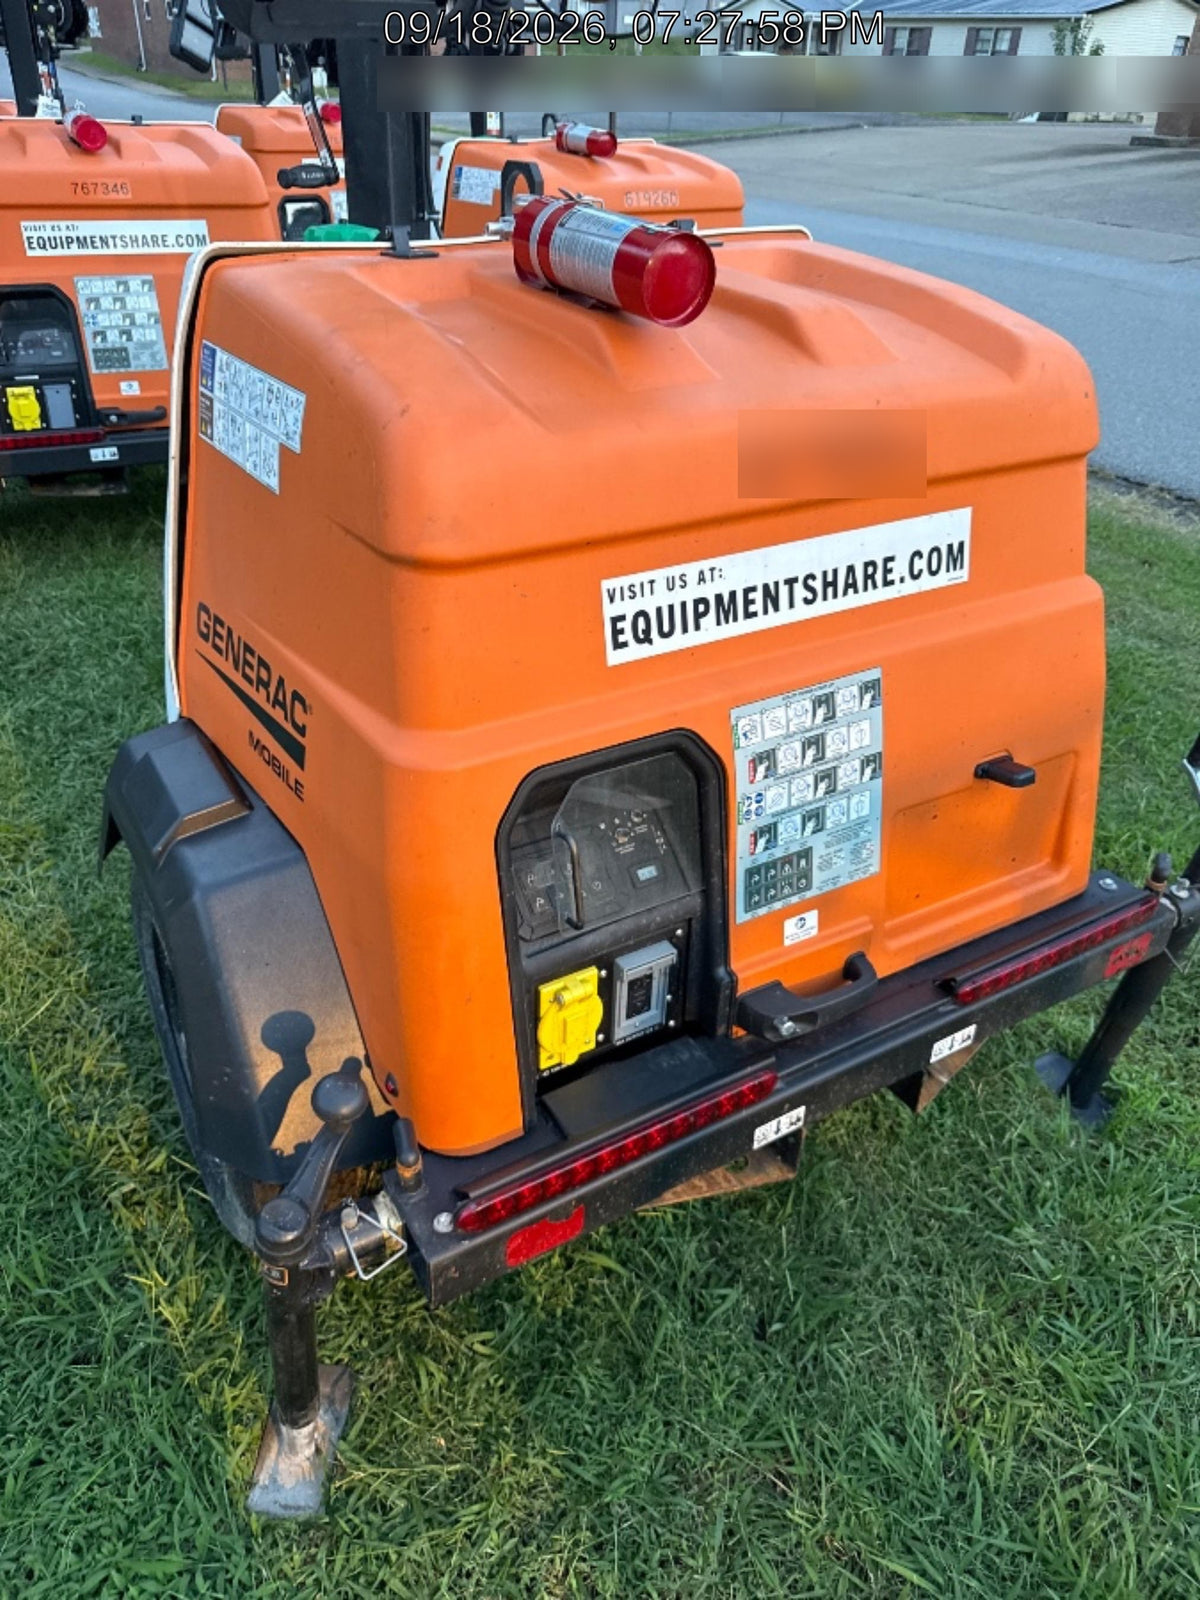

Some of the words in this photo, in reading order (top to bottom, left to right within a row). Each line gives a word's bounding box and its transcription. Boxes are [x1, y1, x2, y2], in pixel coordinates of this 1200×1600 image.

[70, 182, 130, 196] 767346
[26, 233, 208, 252] EQUIPMENTSHARE.COM
[606, 579, 656, 604] VISIT
[666, 573, 688, 592] US
[697, 566, 724, 586] AT:
[609, 539, 966, 651] EQUIPMENTSHARE.COM
[196, 601, 307, 738] GENERAC
[249, 729, 305, 802] MOBILE
